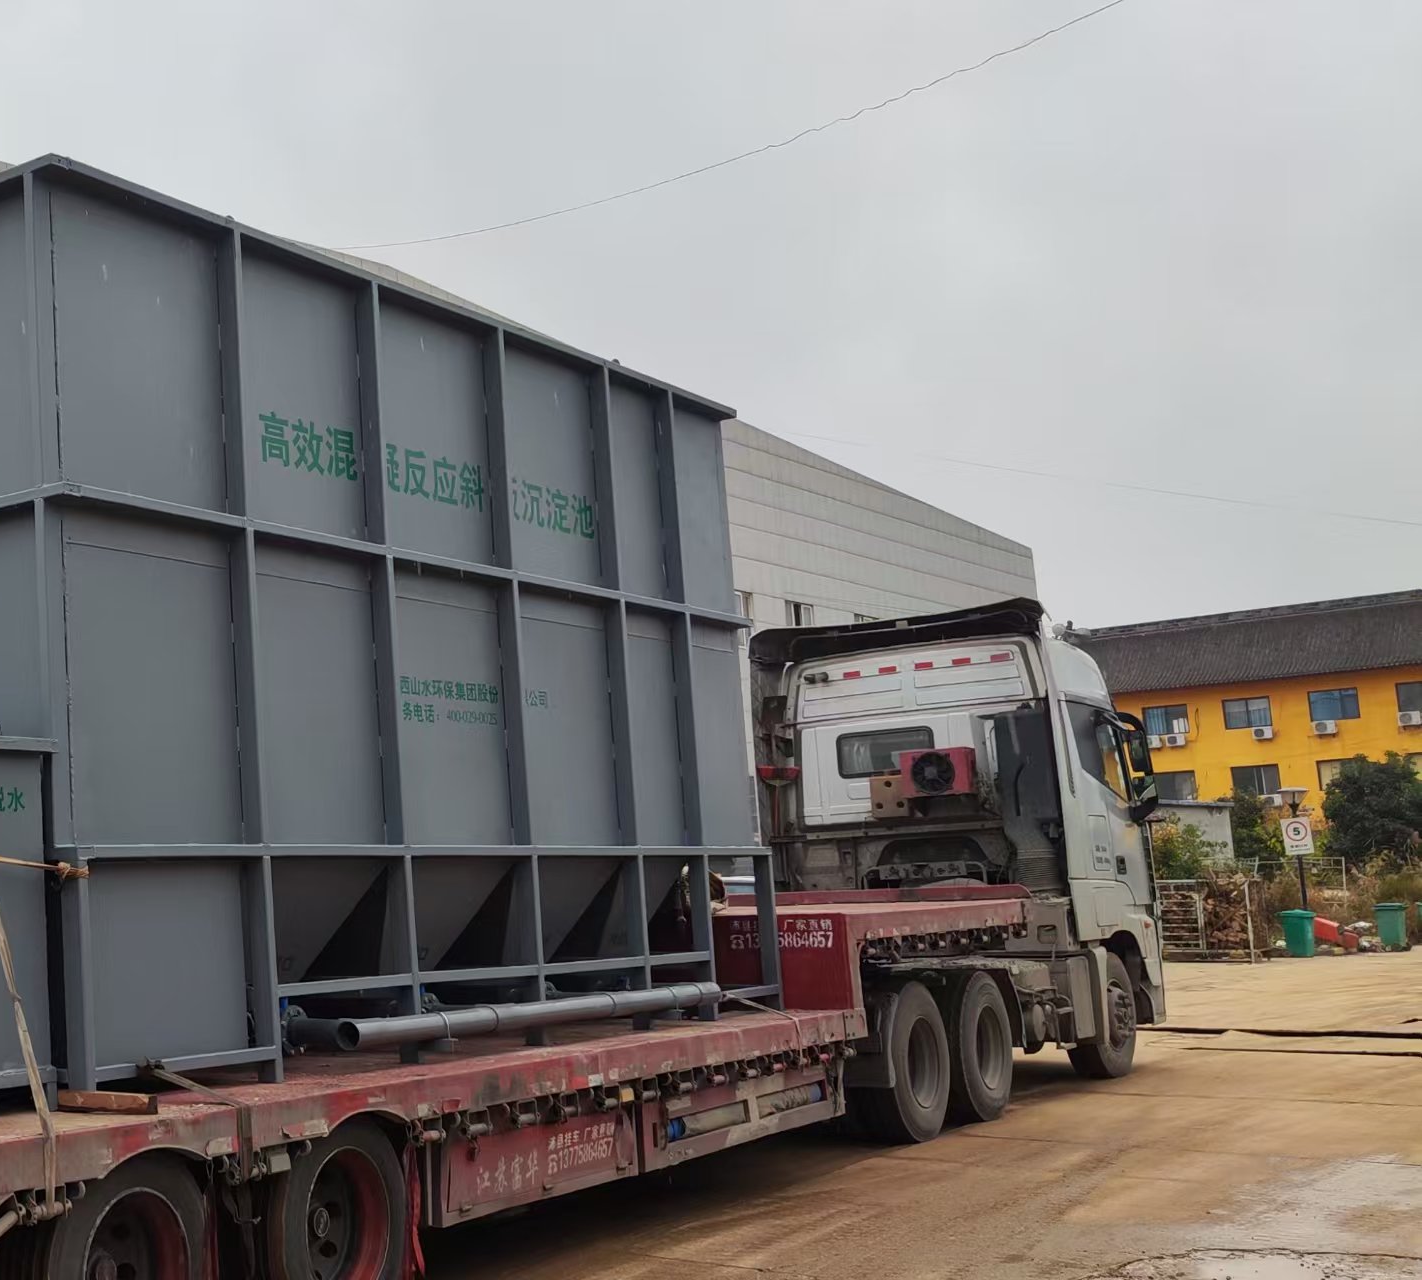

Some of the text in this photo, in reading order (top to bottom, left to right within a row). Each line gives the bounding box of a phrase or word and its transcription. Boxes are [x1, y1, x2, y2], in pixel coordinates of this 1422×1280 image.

[259, 411, 595, 540] 高效混反应斜沉淀池
[399, 675, 548, 708] 西山水环保集团股份公司
[746, 931, 834, 949] 135864657
[558, 1137, 613, 1170] 13775864657
[477, 1149, 539, 1193] 江苏富华
